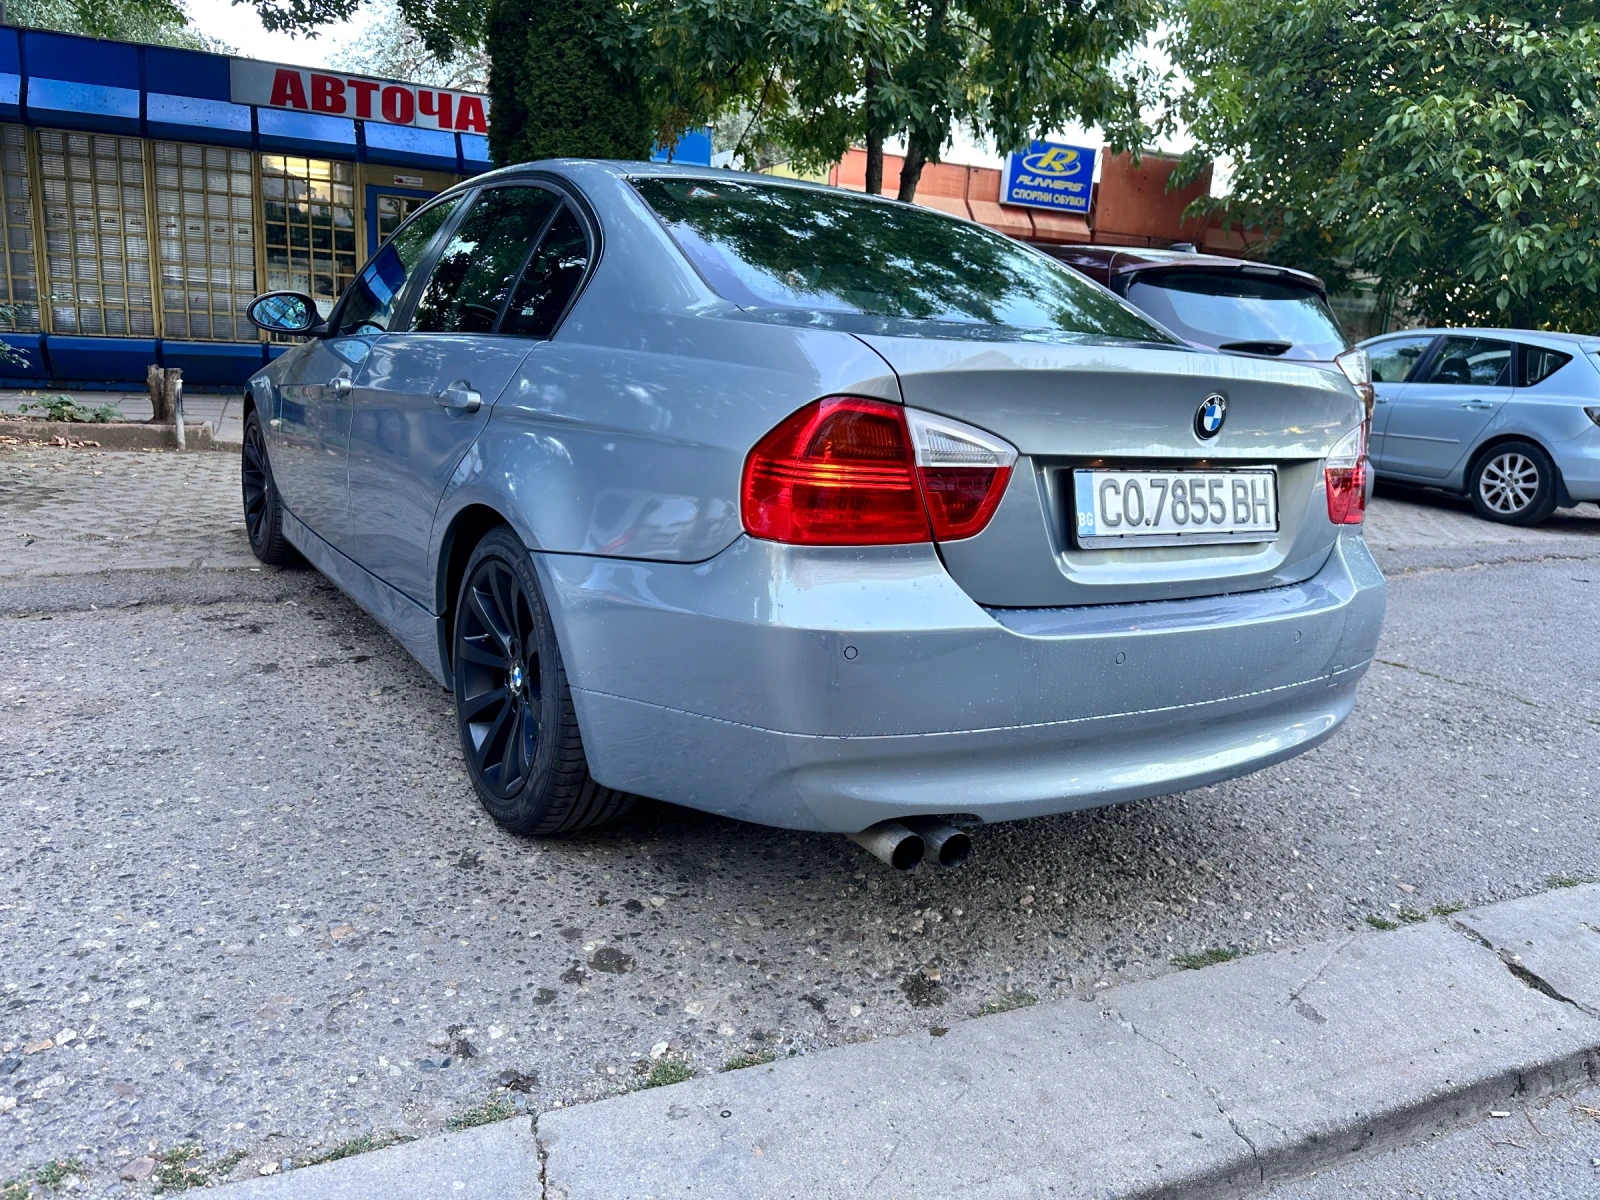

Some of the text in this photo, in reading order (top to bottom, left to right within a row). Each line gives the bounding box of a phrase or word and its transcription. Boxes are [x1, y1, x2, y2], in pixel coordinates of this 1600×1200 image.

[270, 68, 488, 133] АВТОЧА
[1016, 175, 1083, 192] RUNNERS
[1012, 188, 1086, 207] СПОРТНИ ОБУВКИ
[1079, 512, 1094, 527] BG
